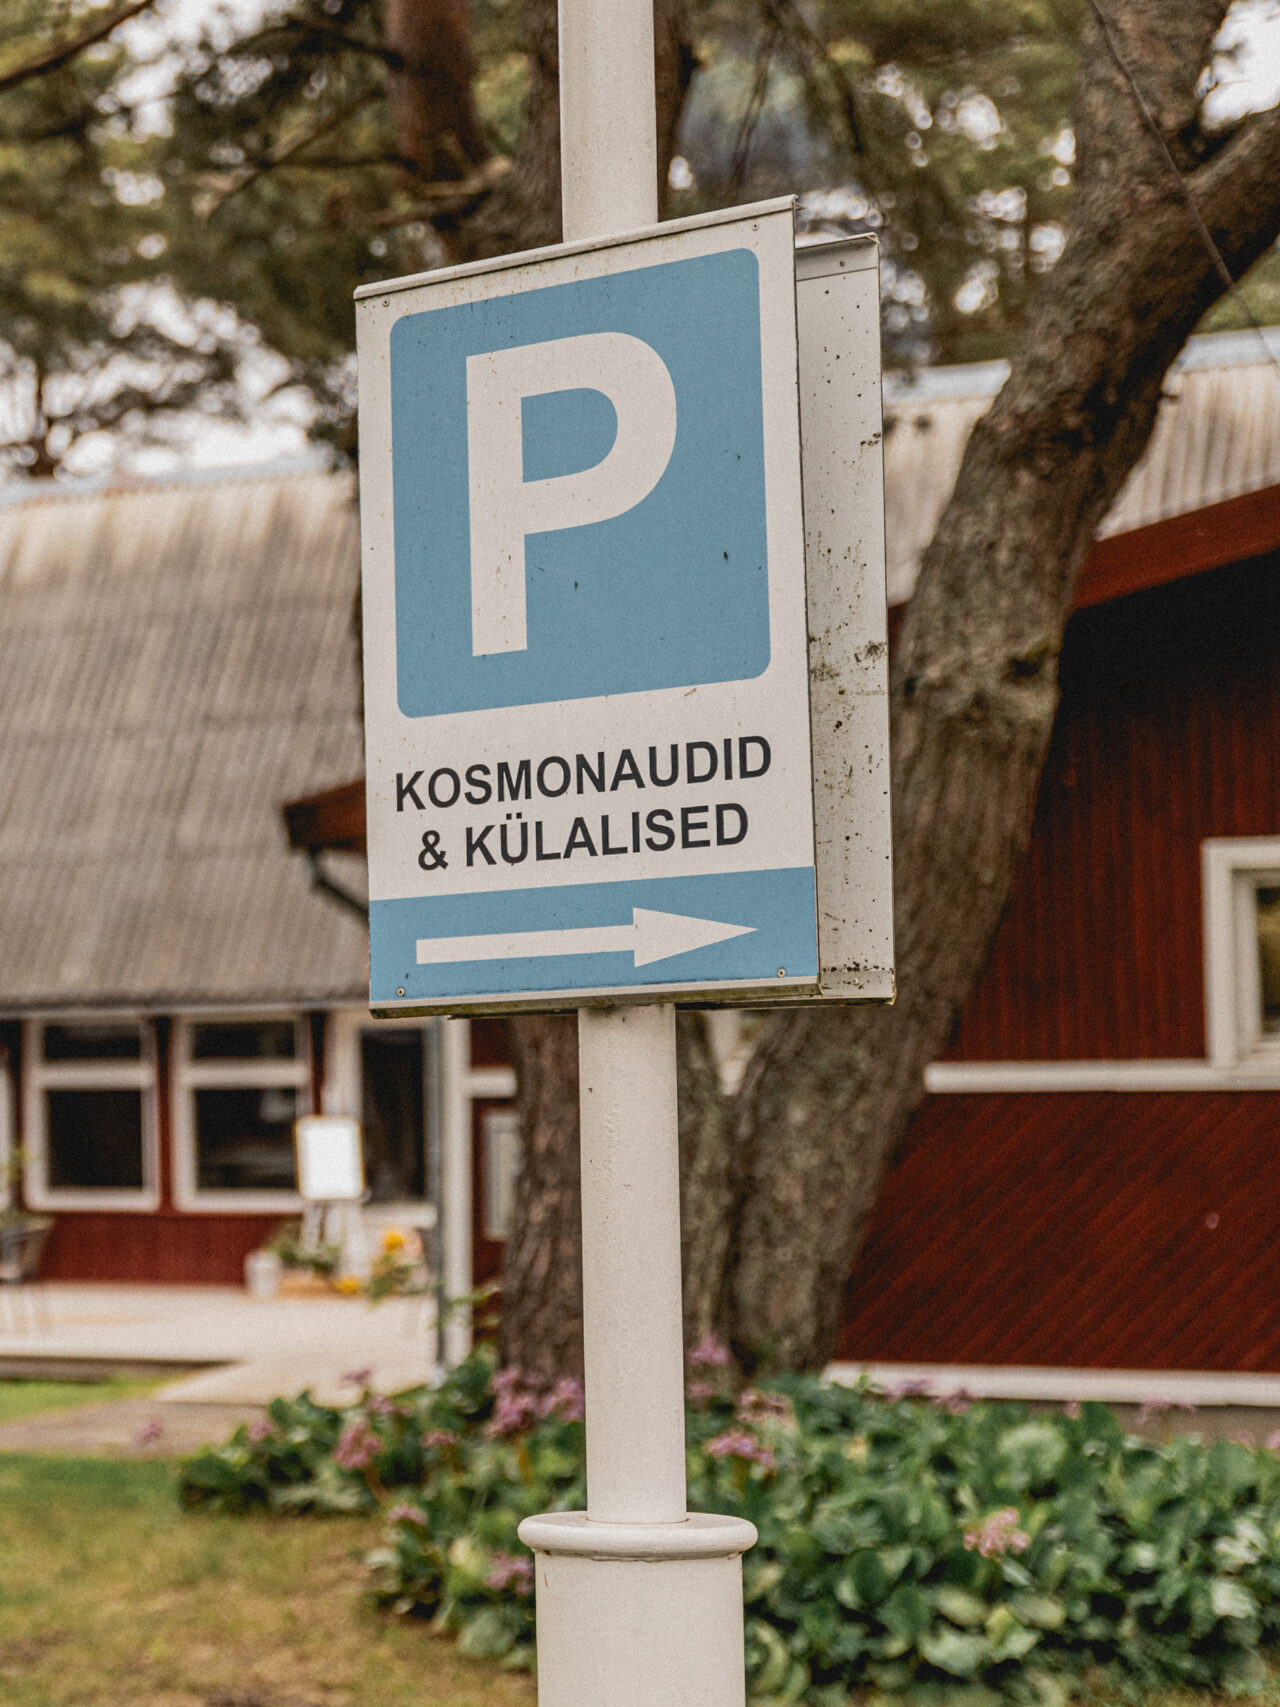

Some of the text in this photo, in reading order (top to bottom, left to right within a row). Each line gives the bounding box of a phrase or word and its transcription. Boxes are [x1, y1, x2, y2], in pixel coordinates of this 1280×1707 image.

[466, 332, 677, 656] P
[395, 735, 772, 812] KOSMONAUDID
[418, 802, 749, 870] & KÜLALISED
